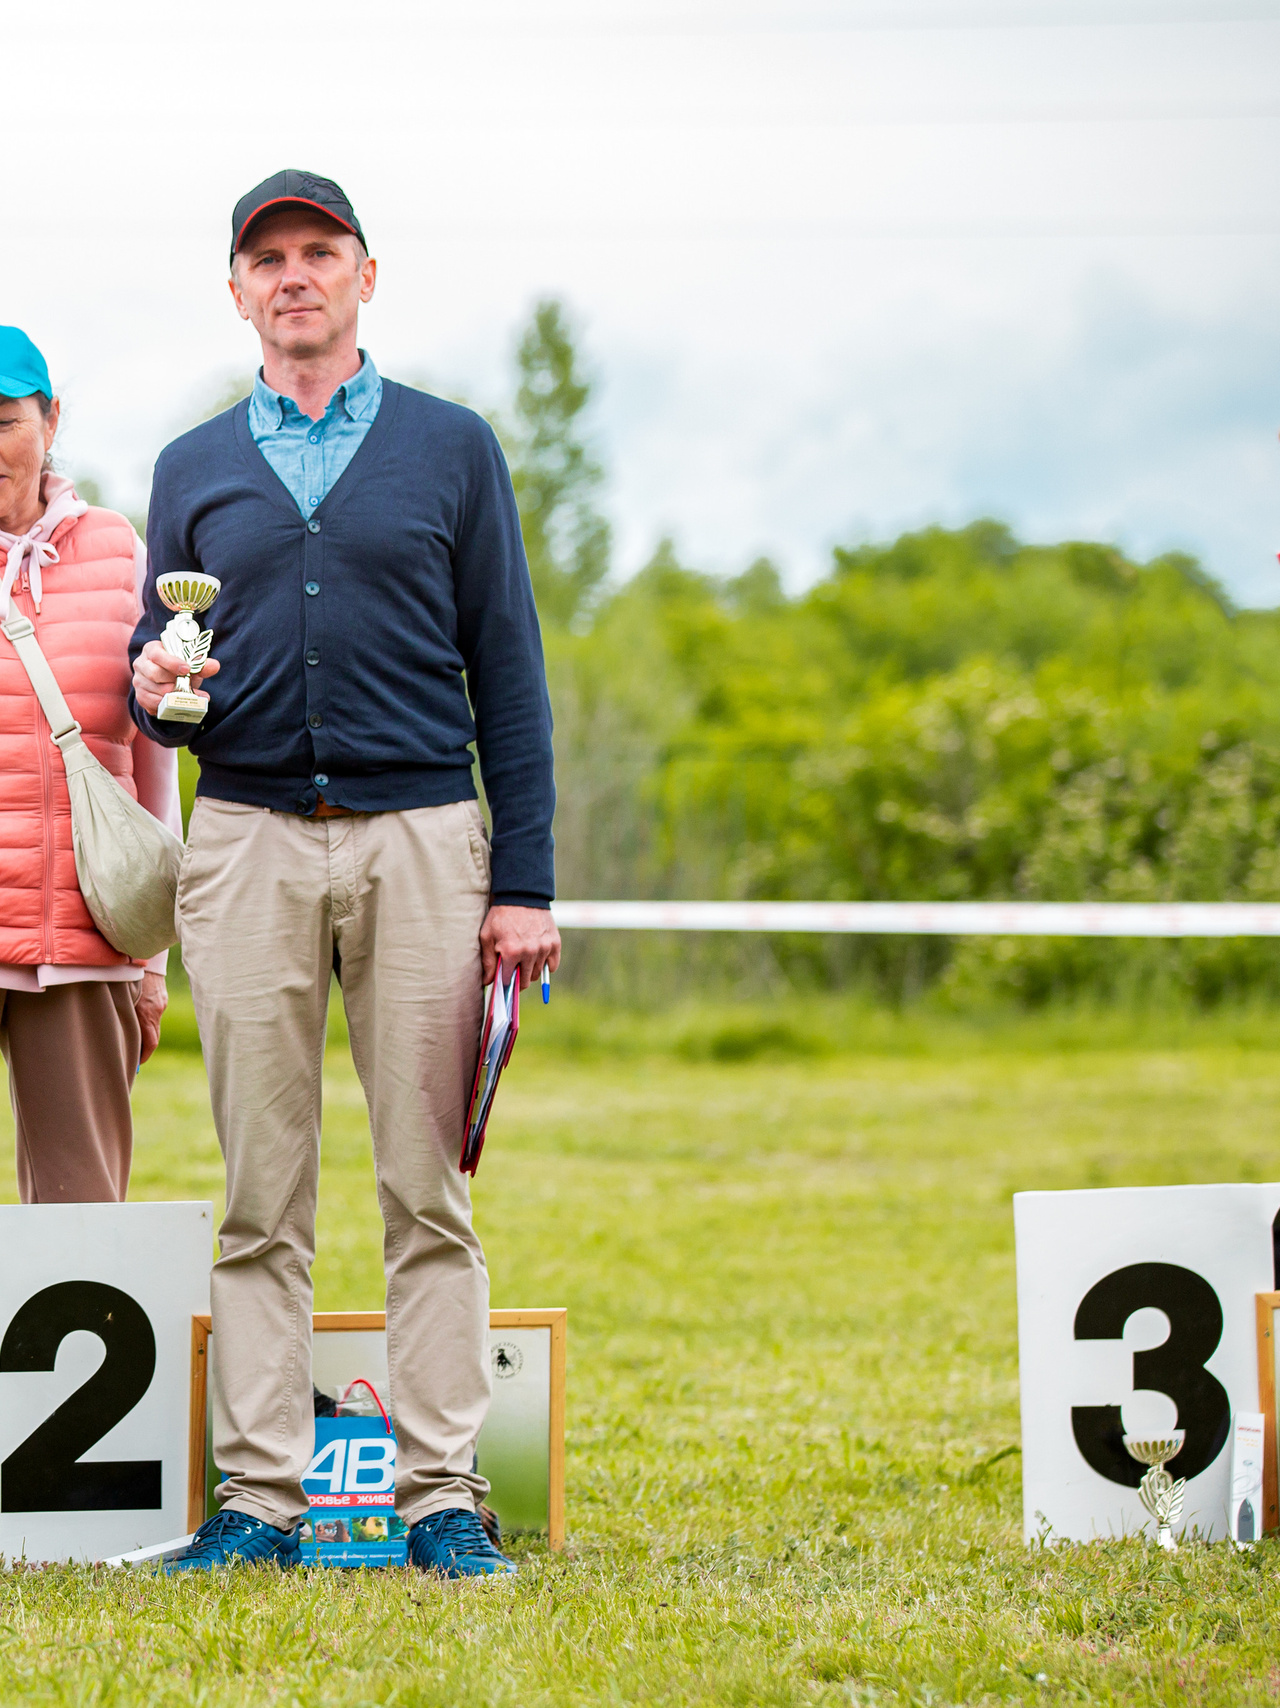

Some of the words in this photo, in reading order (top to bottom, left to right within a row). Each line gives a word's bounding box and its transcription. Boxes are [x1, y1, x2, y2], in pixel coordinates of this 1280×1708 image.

[0, 1280, 163, 1514] 2
[300, 1437, 398, 1493] АВ
[1071, 1261, 1231, 1489] 3
